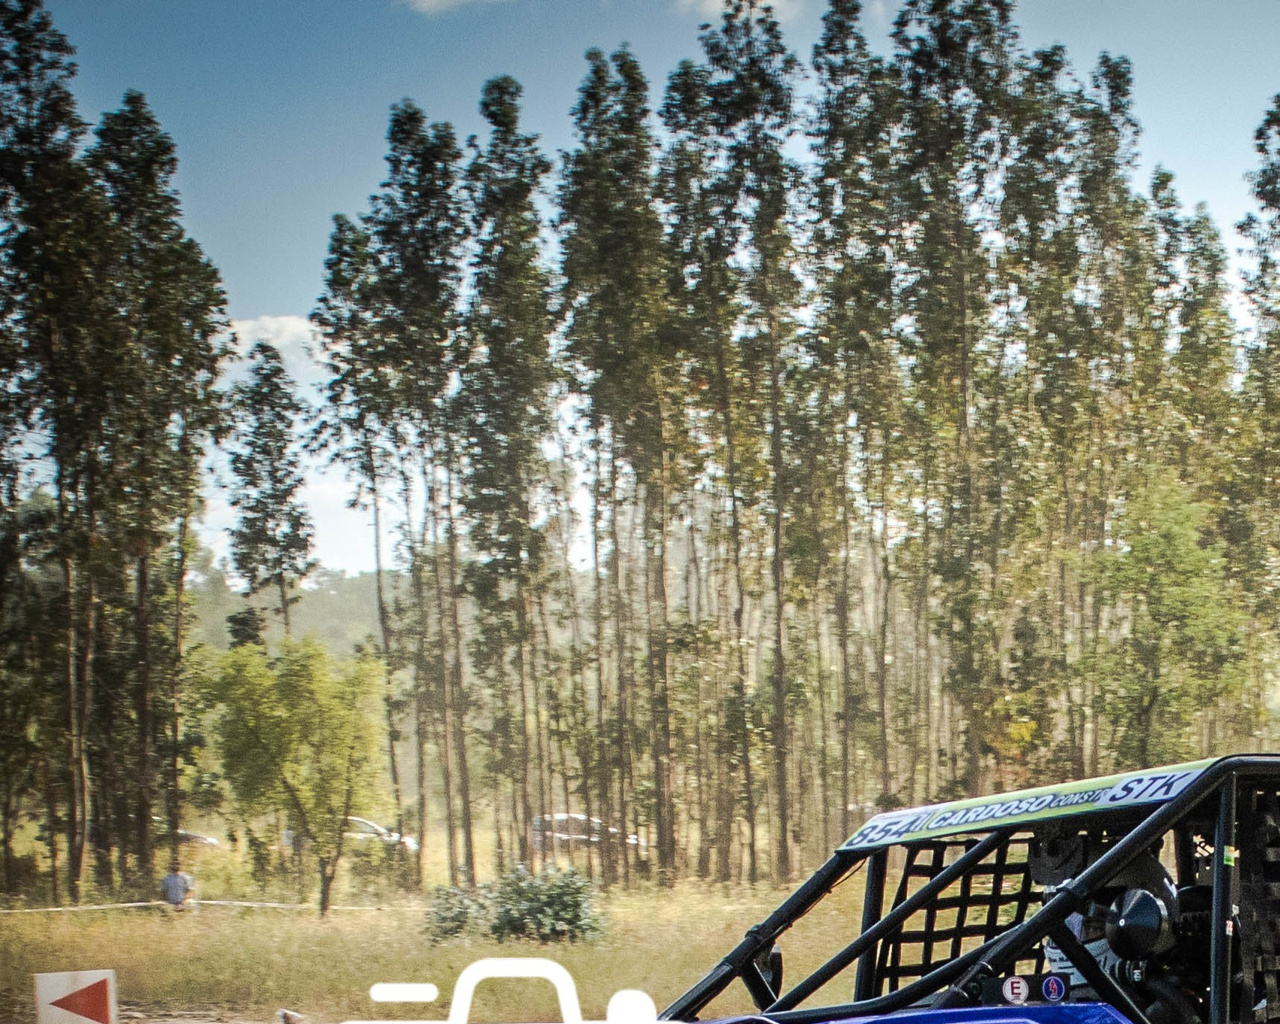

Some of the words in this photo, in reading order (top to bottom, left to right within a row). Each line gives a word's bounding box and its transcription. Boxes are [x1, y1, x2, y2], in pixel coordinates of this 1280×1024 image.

[846, 816, 922, 847] 854
[928, 793, 1054, 830] CARDOSO
[1109, 772, 1192, 802] STK
[1010, 981, 1021, 996] E
